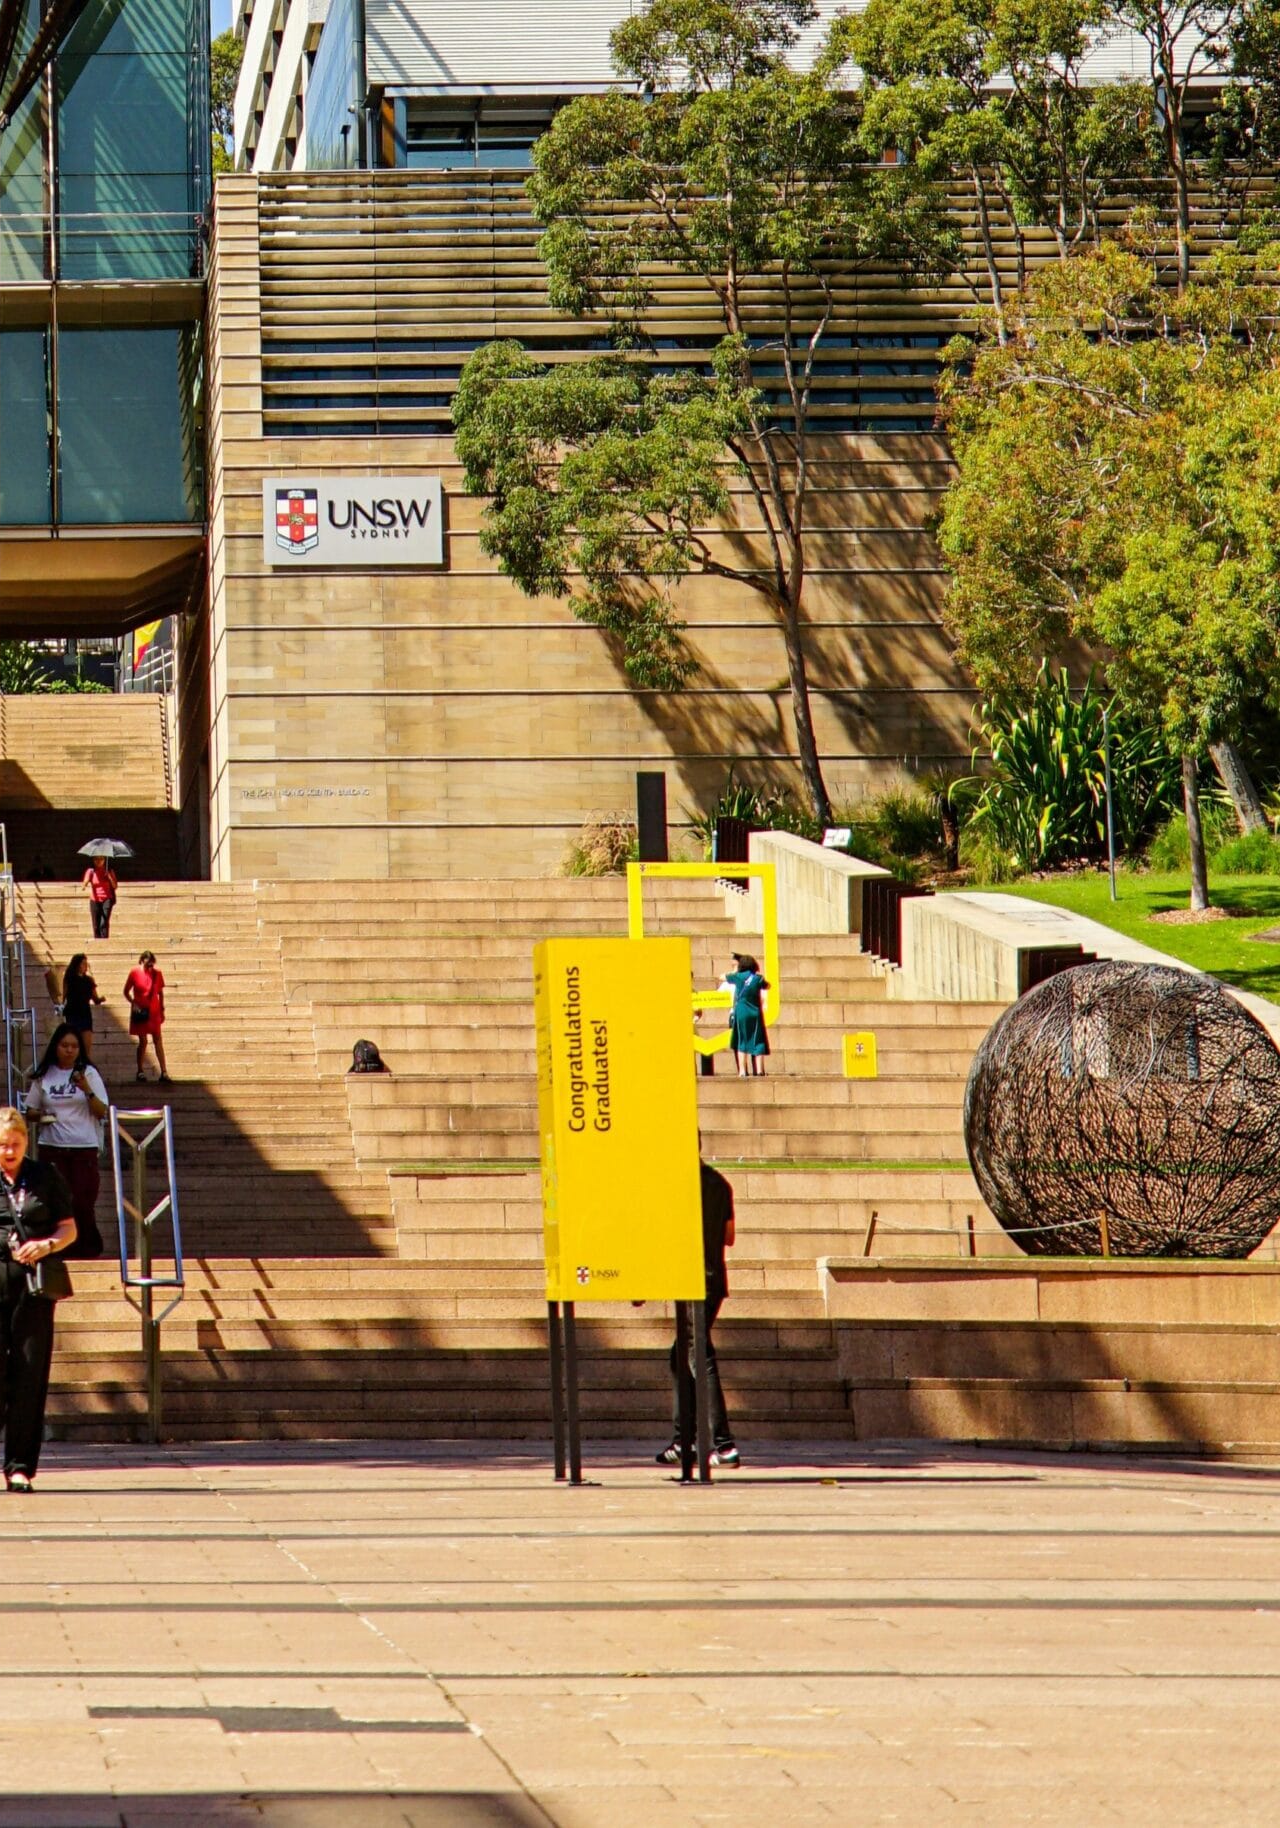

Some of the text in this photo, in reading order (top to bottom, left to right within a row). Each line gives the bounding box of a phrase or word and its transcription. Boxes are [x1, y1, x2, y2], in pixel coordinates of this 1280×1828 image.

[327, 499, 431, 529] UNSW
[350, 529, 410, 538] SYDNEY
[563, 966, 589, 1133] Congratulations
[590, 1020, 611, 1133] Graduates!
[591, 1269, 621, 1278] UNSW
